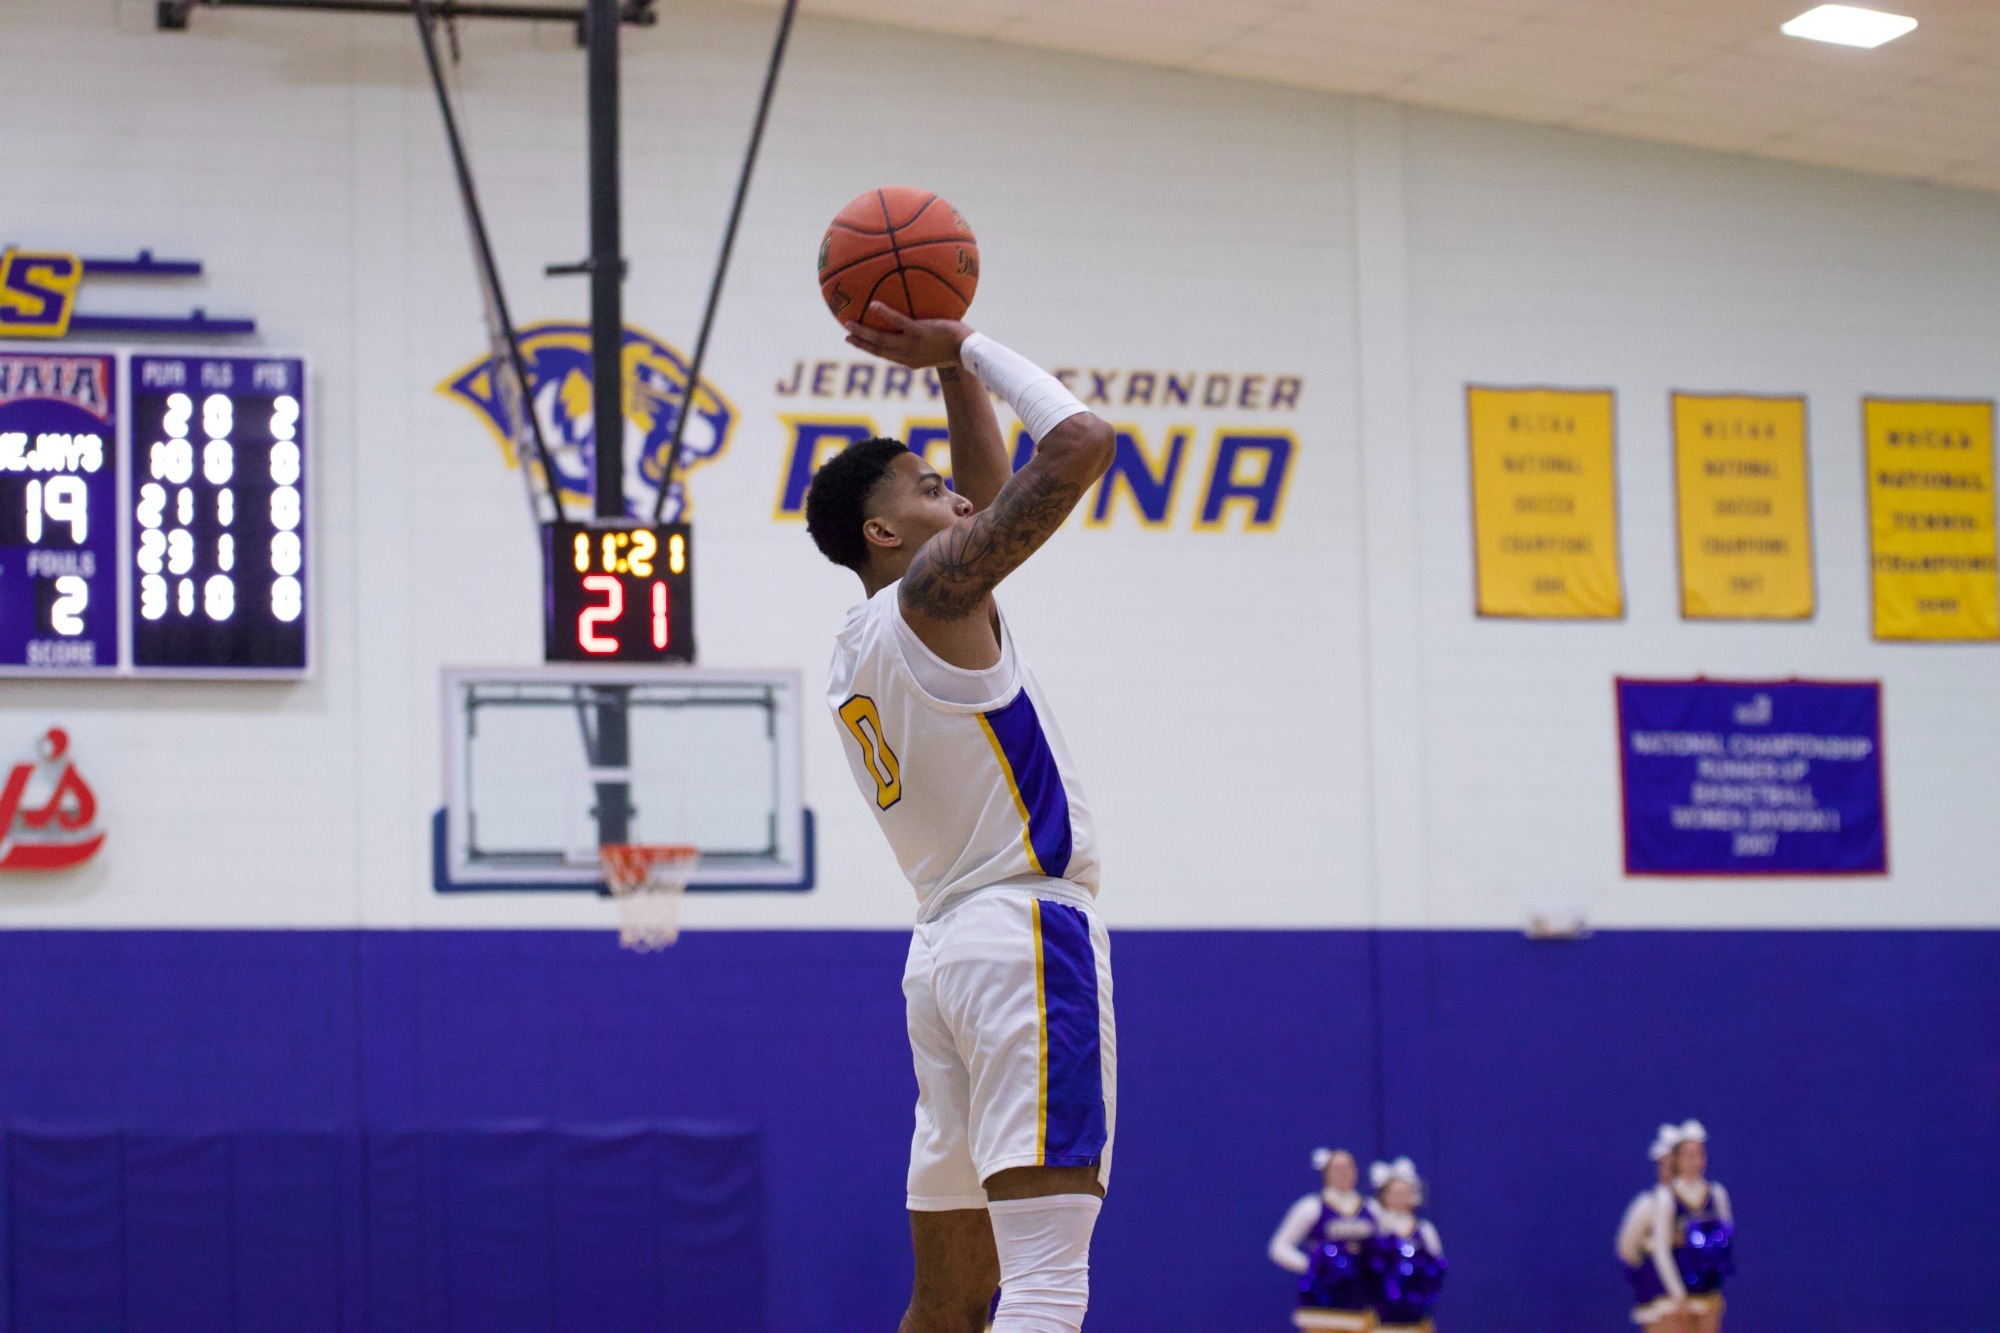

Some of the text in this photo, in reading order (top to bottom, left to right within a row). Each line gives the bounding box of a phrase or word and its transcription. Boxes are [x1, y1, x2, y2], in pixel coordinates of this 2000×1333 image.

[164, 393, 299, 440] 2 0 2
[204, 439, 233, 484] 0
[270, 440, 300, 485] 0
[26, 475, 88, 544] 19
[217, 488, 234, 526] 1
[271, 485, 300, 530] 0
[218, 533, 235, 571] 1
[271, 530, 301, 575] 0
[574, 528, 685, 578] 11:21
[52, 575, 88, 635] 2
[205, 574, 235, 620] 0
[272, 575, 301, 621] 0
[576, 574, 670, 656] 21
[838, 693, 902, 812] 0
